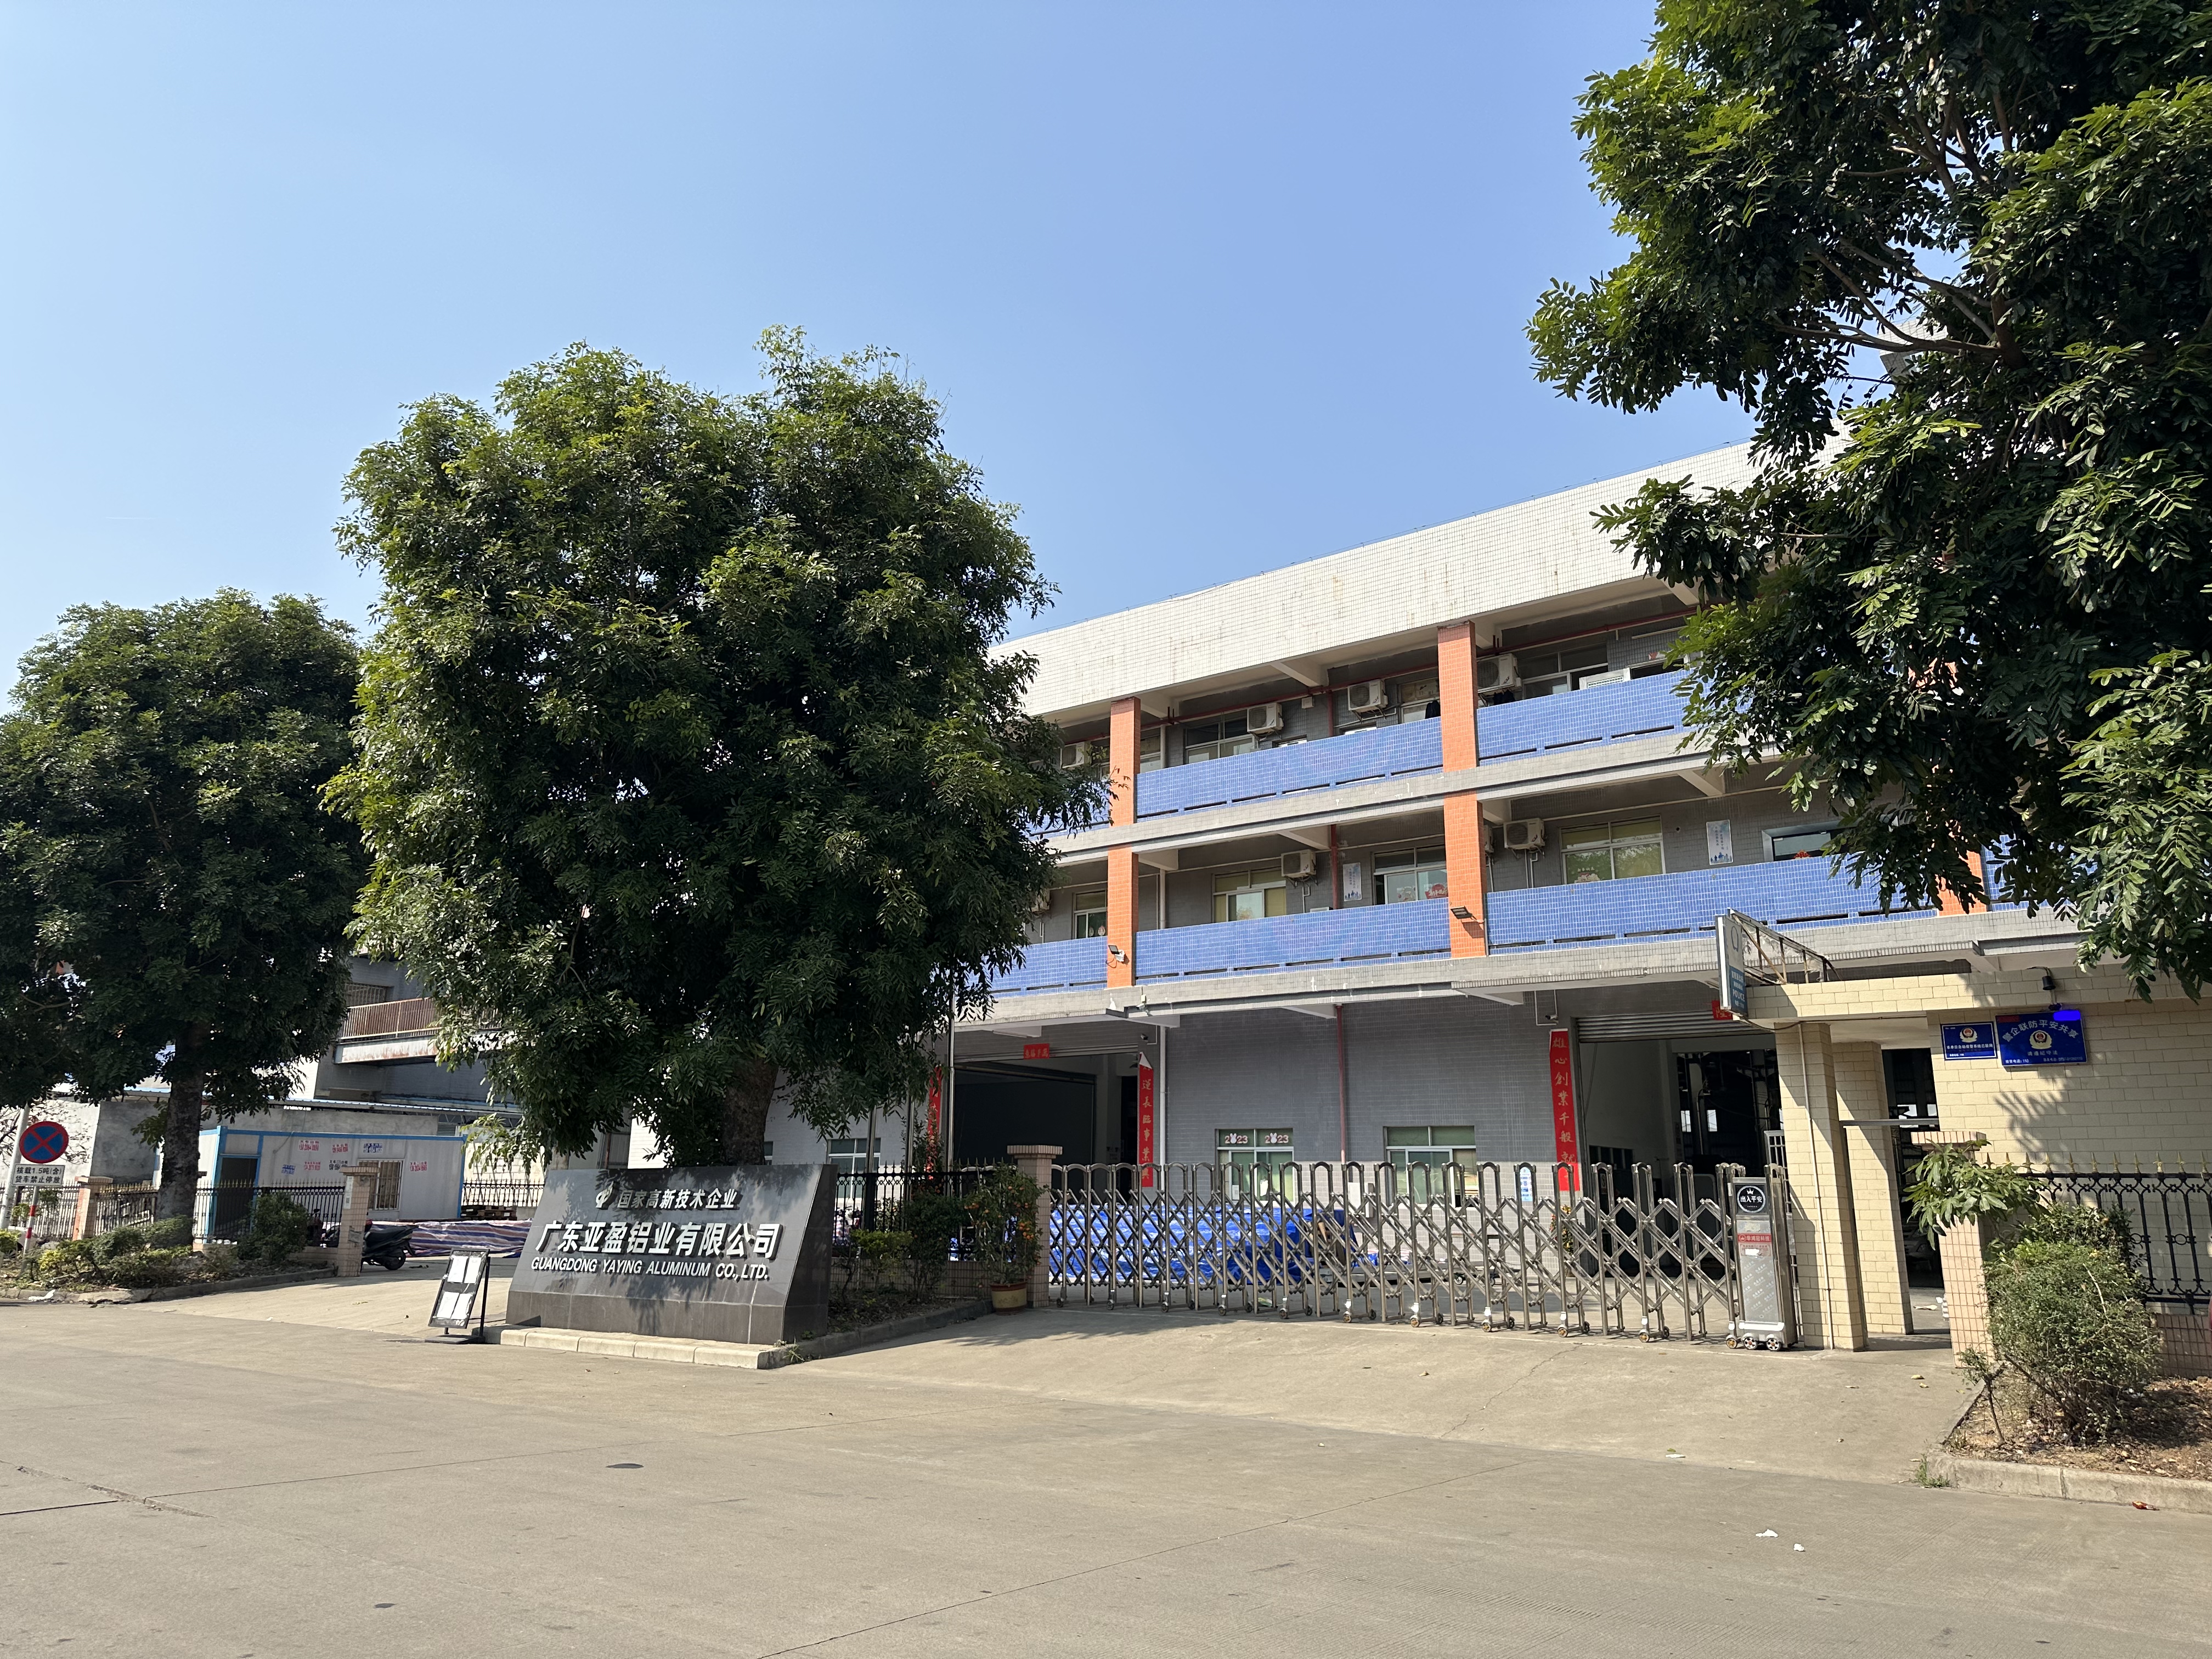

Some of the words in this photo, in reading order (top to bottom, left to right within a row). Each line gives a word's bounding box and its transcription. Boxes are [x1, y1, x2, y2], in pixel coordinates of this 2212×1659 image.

[1733, 989, 1745, 1002] POLICE
[15, 1175, 60, 1183] 货车禁止停放
[617, 1188, 738, 1209] 国家高新技术企业
[535, 1221, 780, 1259] 广东亚盈铝业有限公司
[531, 1256, 598, 1273] GUANGDONG
[602, 1259, 642, 1275] YAYING
[646, 1261, 711, 1277] ALUMINUM
